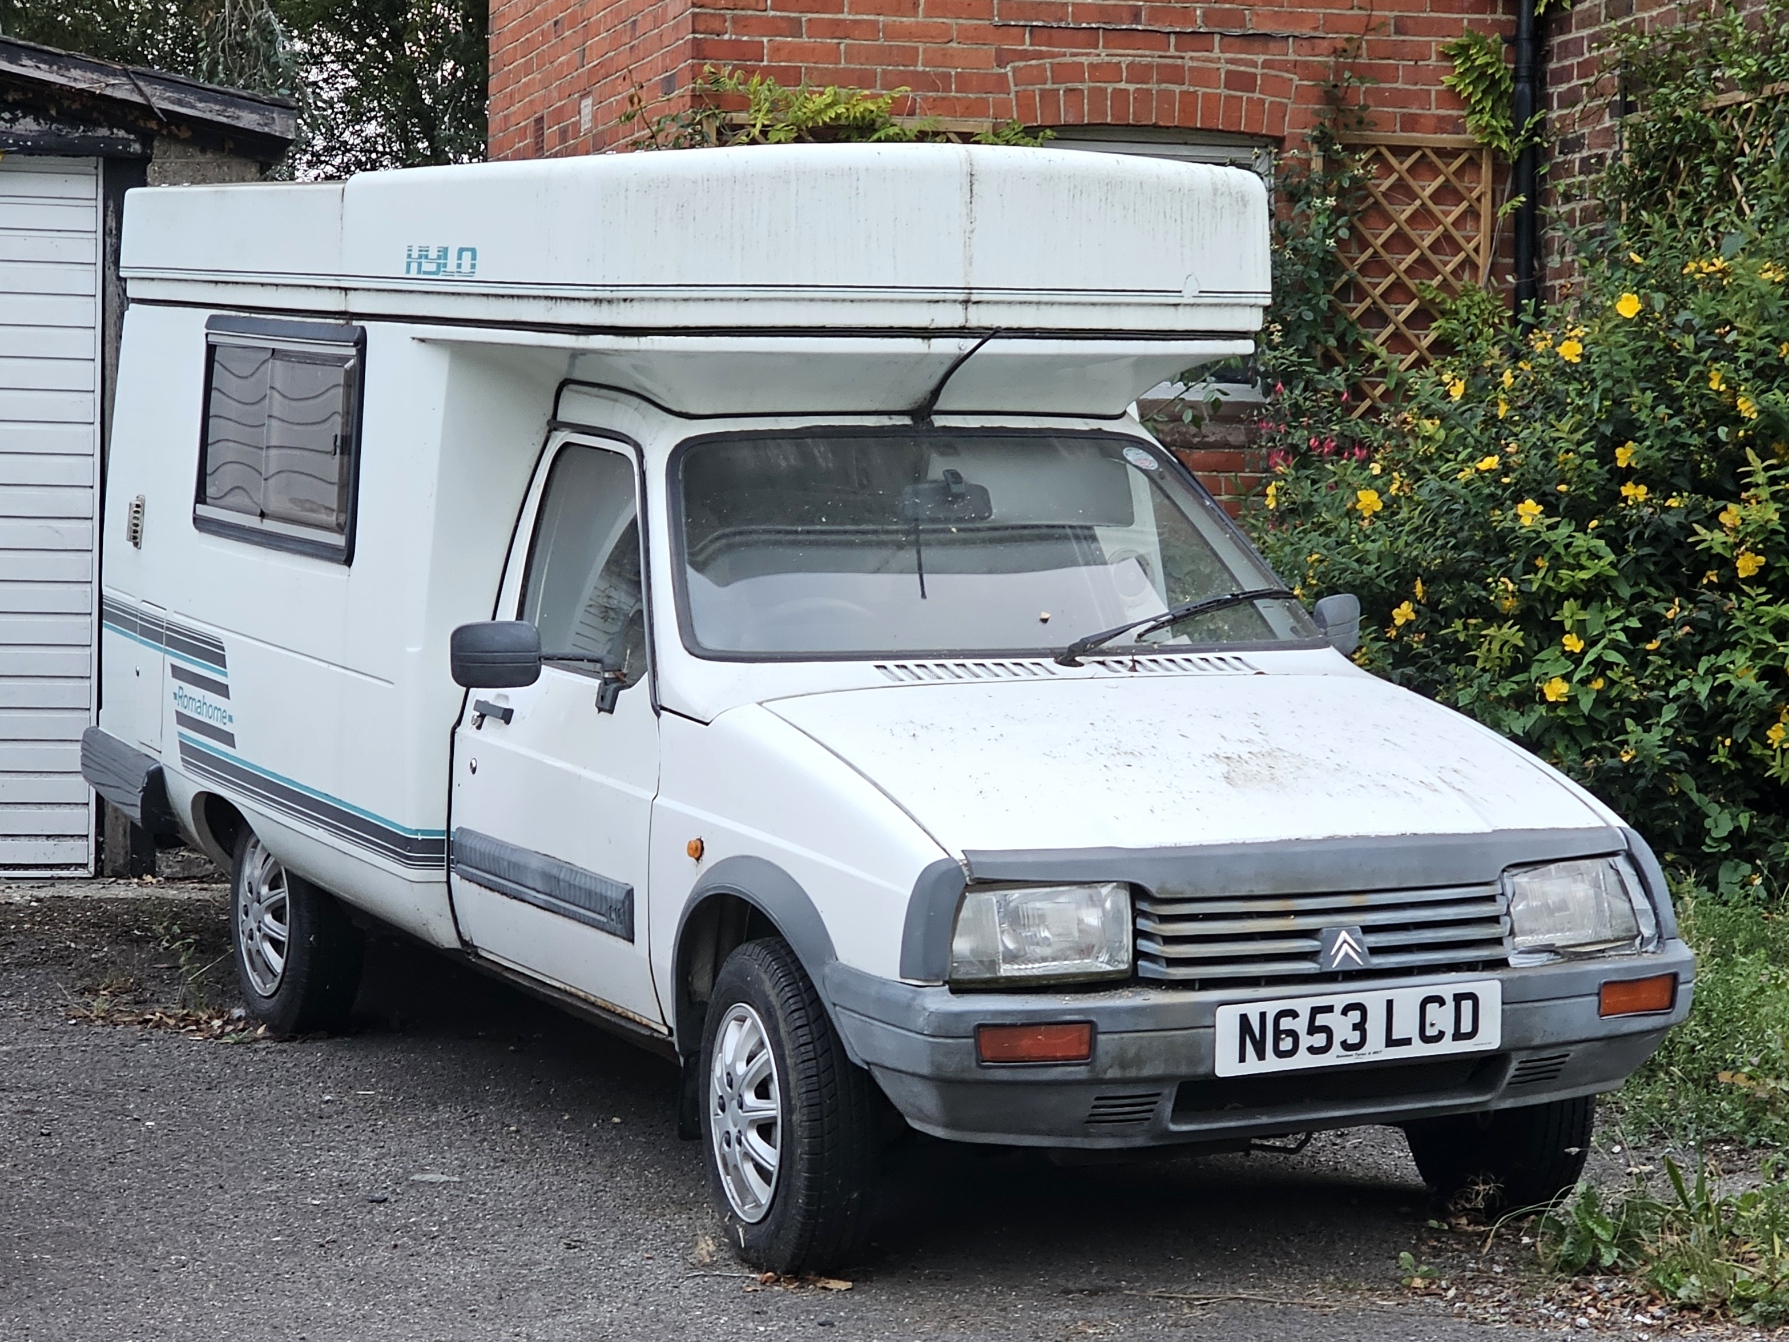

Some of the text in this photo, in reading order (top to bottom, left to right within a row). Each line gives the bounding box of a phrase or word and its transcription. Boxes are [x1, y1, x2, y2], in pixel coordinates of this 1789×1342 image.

[405, 245, 477, 278] HYLO
[177, 686, 228, 726] Romahome
[1238, 991, 1480, 1064] N653 LCD
